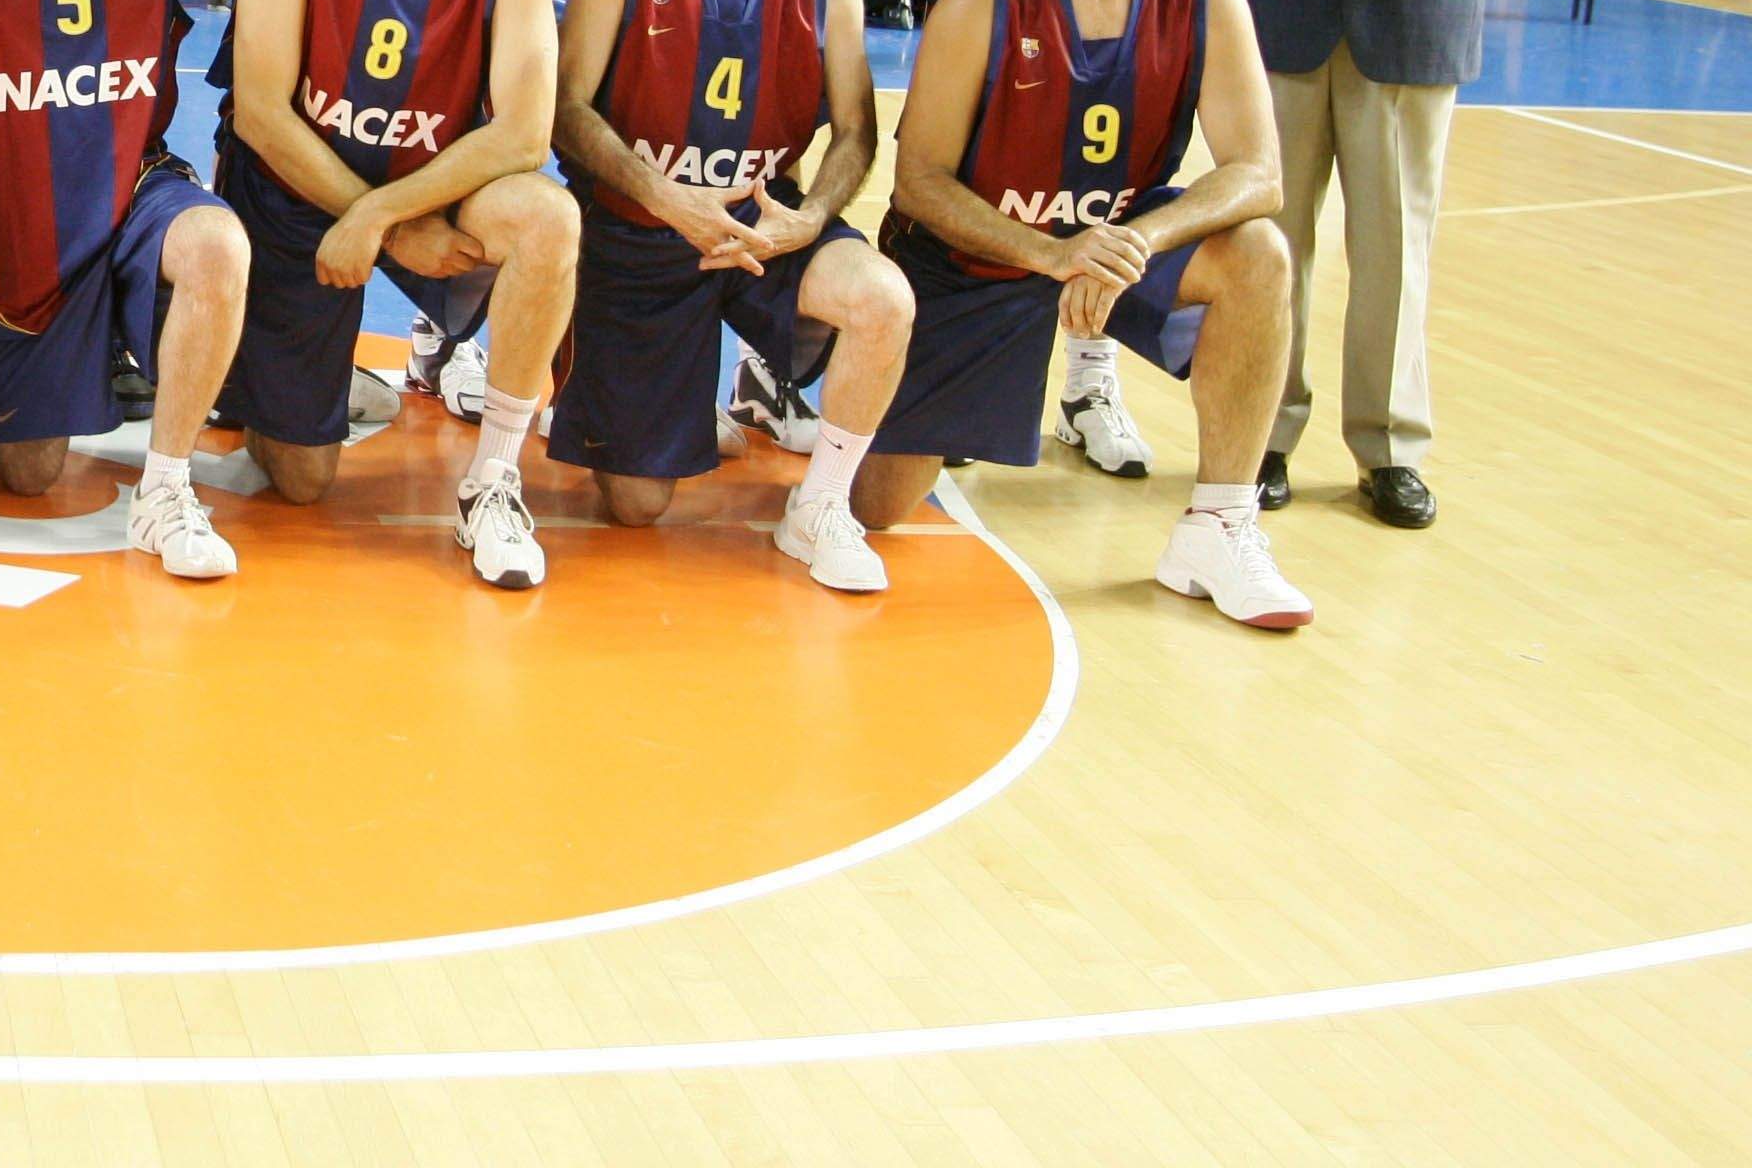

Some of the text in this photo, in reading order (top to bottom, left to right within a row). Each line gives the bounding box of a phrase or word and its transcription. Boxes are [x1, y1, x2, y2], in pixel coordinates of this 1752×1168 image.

[363, 17, 409, 81] 8
[703, 56, 744, 121] 4
[633, 138, 789, 187] NACEX
[1081, 103, 1121, 165] 9
[999, 188, 1136, 225] NACE
